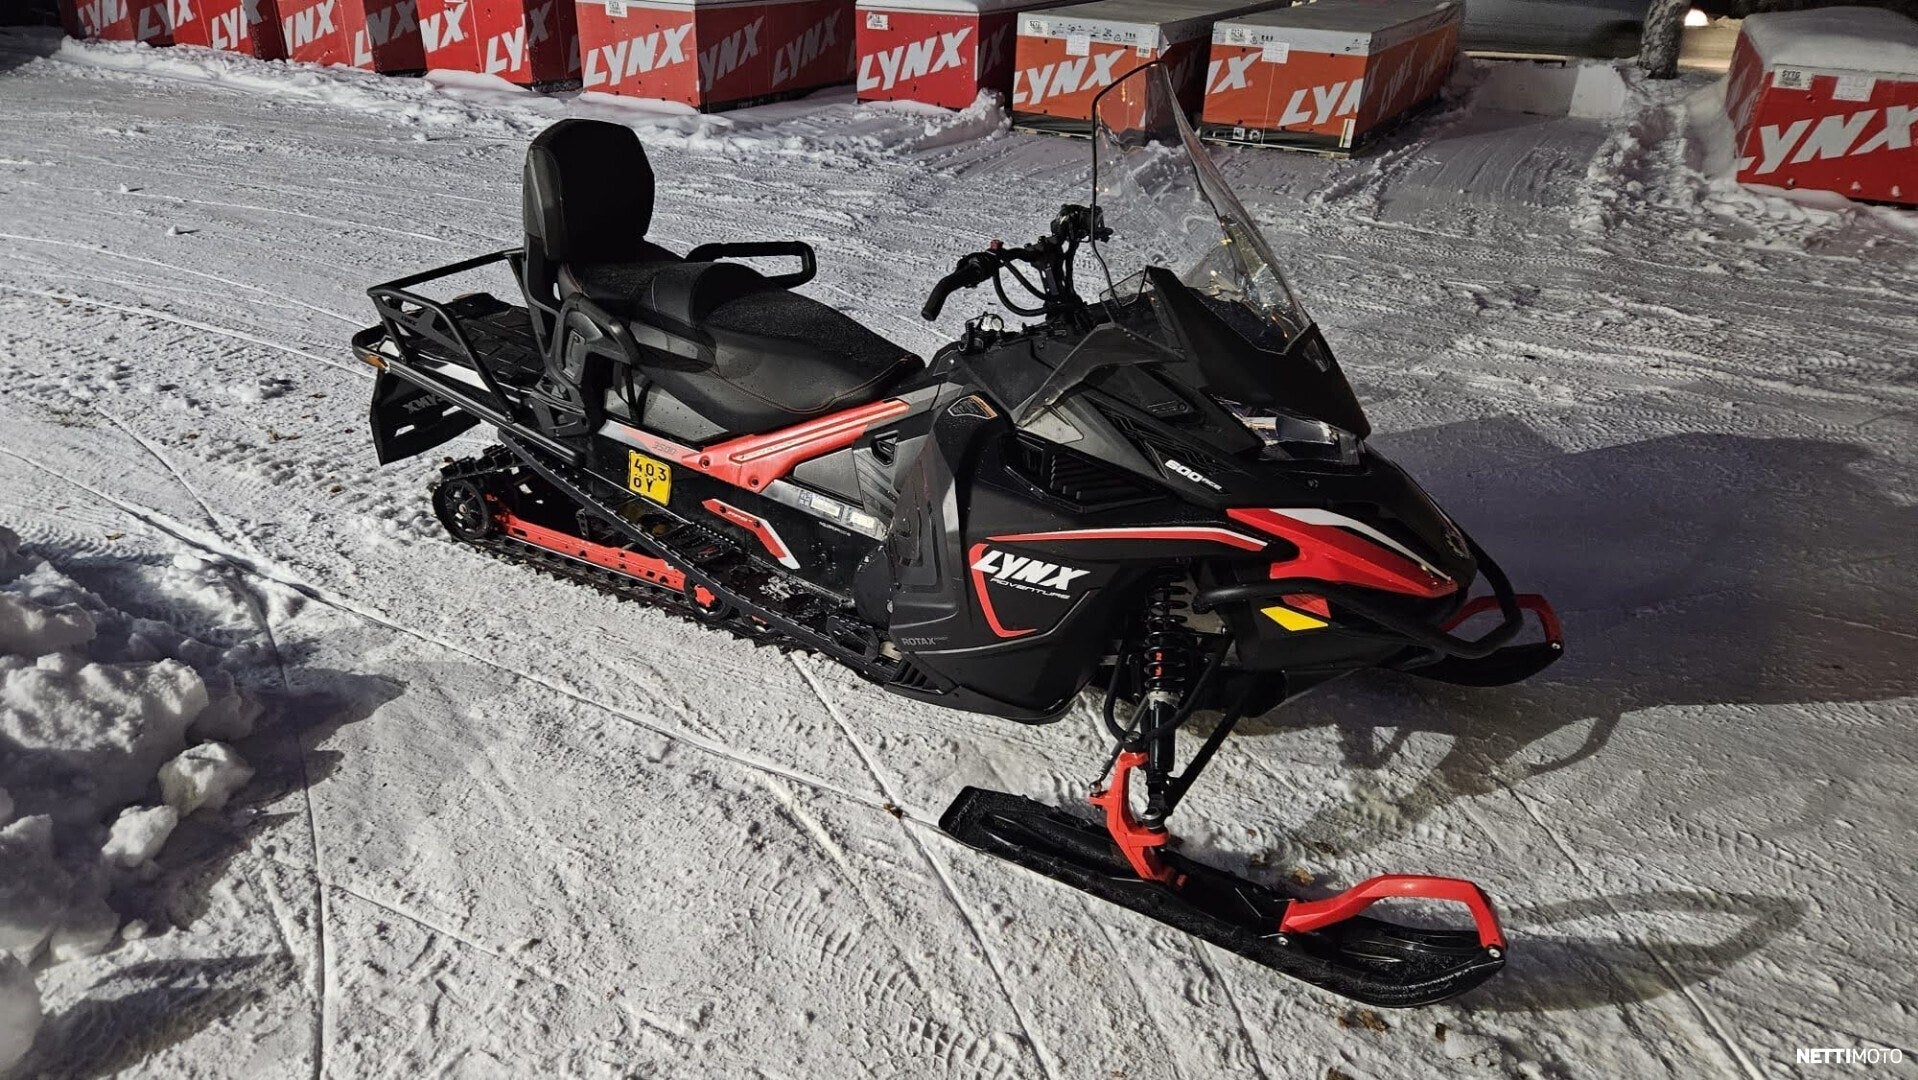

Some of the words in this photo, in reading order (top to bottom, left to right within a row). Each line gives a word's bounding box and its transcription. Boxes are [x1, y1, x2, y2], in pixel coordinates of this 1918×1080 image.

[582, 22, 694, 89] LYNX
[771, 7, 842, 89] LYNX
[856, 26, 973, 93] LYNX
[634, 458, 668, 482] 403
[970, 549, 1091, 591] LYNX
[990, 576, 1071, 600] ADVENTURE
[901, 637, 937, 646] ROTAX
